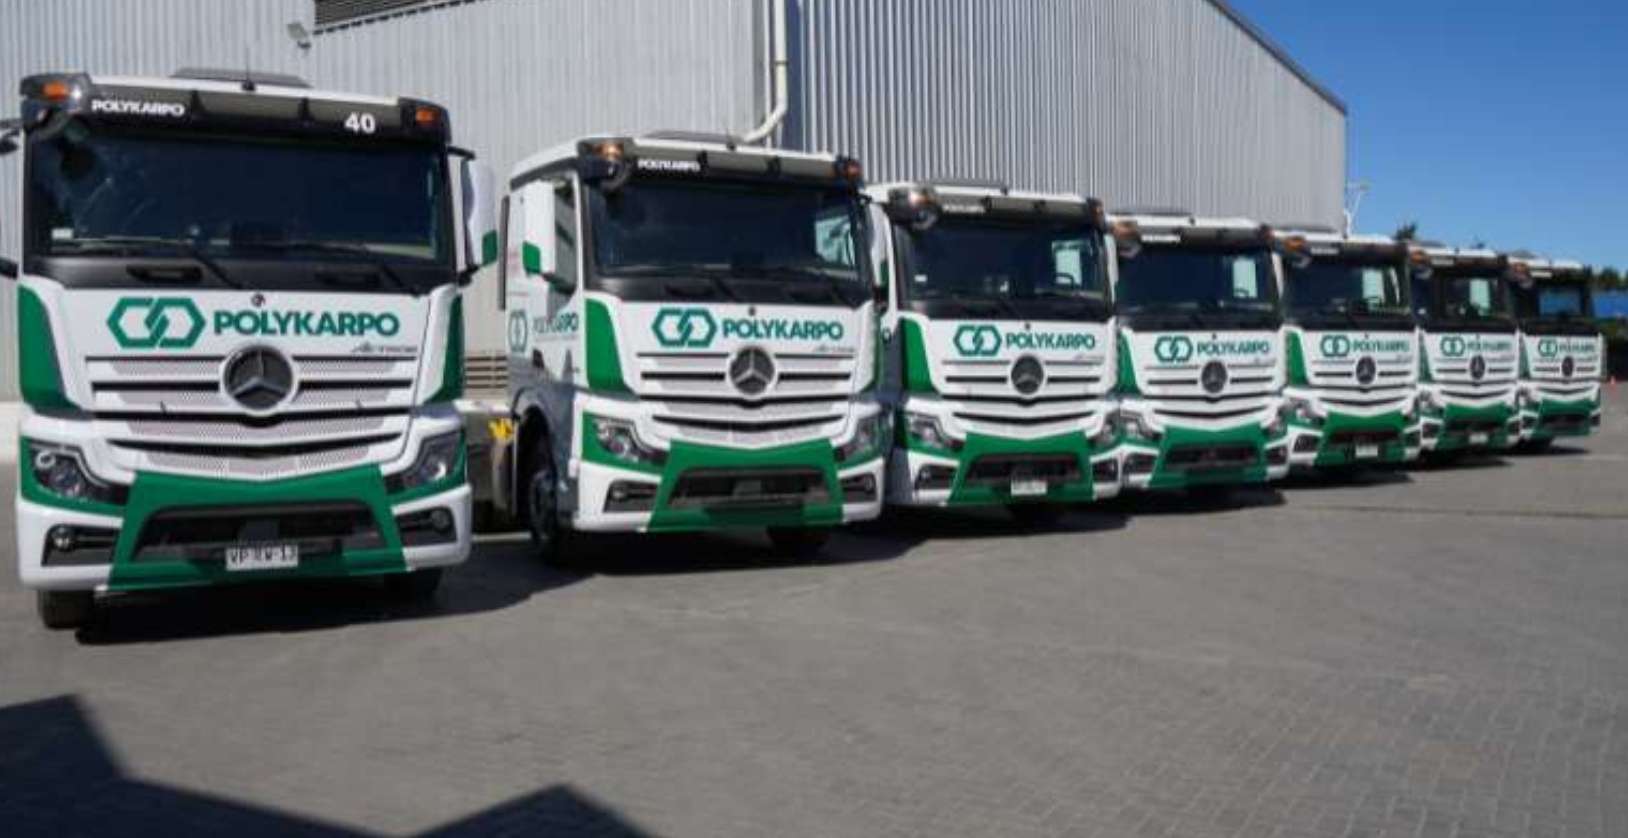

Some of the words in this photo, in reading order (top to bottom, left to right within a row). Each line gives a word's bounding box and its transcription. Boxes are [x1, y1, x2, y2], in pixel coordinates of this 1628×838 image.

[91, 100, 185, 117] POLYKARPO
[345, 112, 375, 134] 40
[213, 310, 400, 336] POLYKARPO
[722, 318, 843, 340] POLYKARPO
[1006, 332, 1096, 350] POLYKARPO
